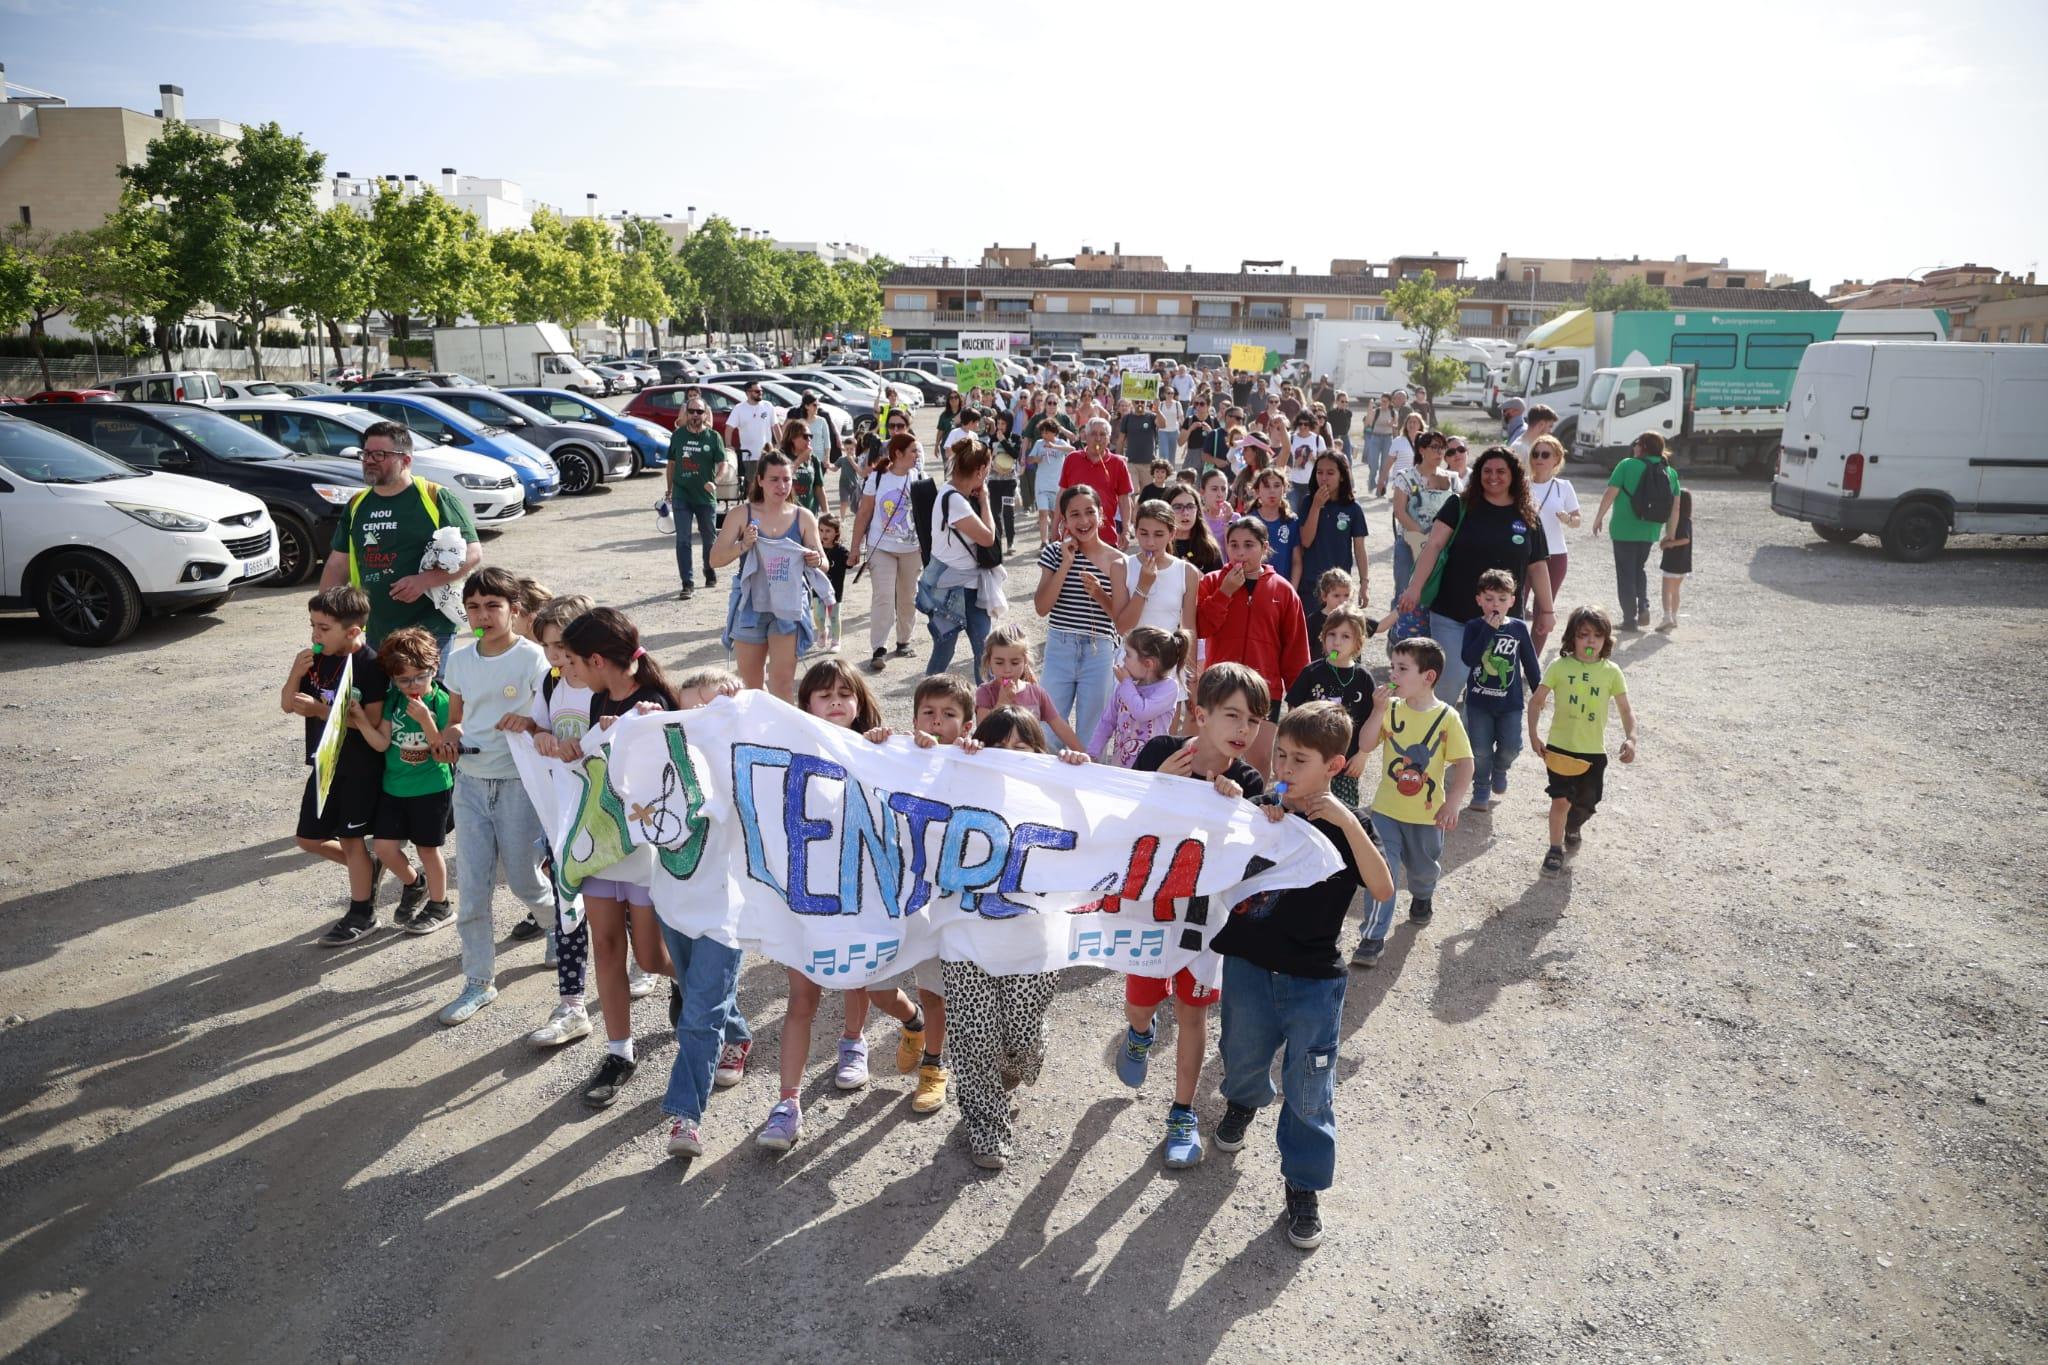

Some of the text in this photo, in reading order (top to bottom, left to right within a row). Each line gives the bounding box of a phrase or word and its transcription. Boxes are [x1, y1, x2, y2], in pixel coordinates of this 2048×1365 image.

[370, 509, 392, 519] NOU
[362, 522, 398, 532] CENTRE
[1494, 638, 1520, 656] REX
